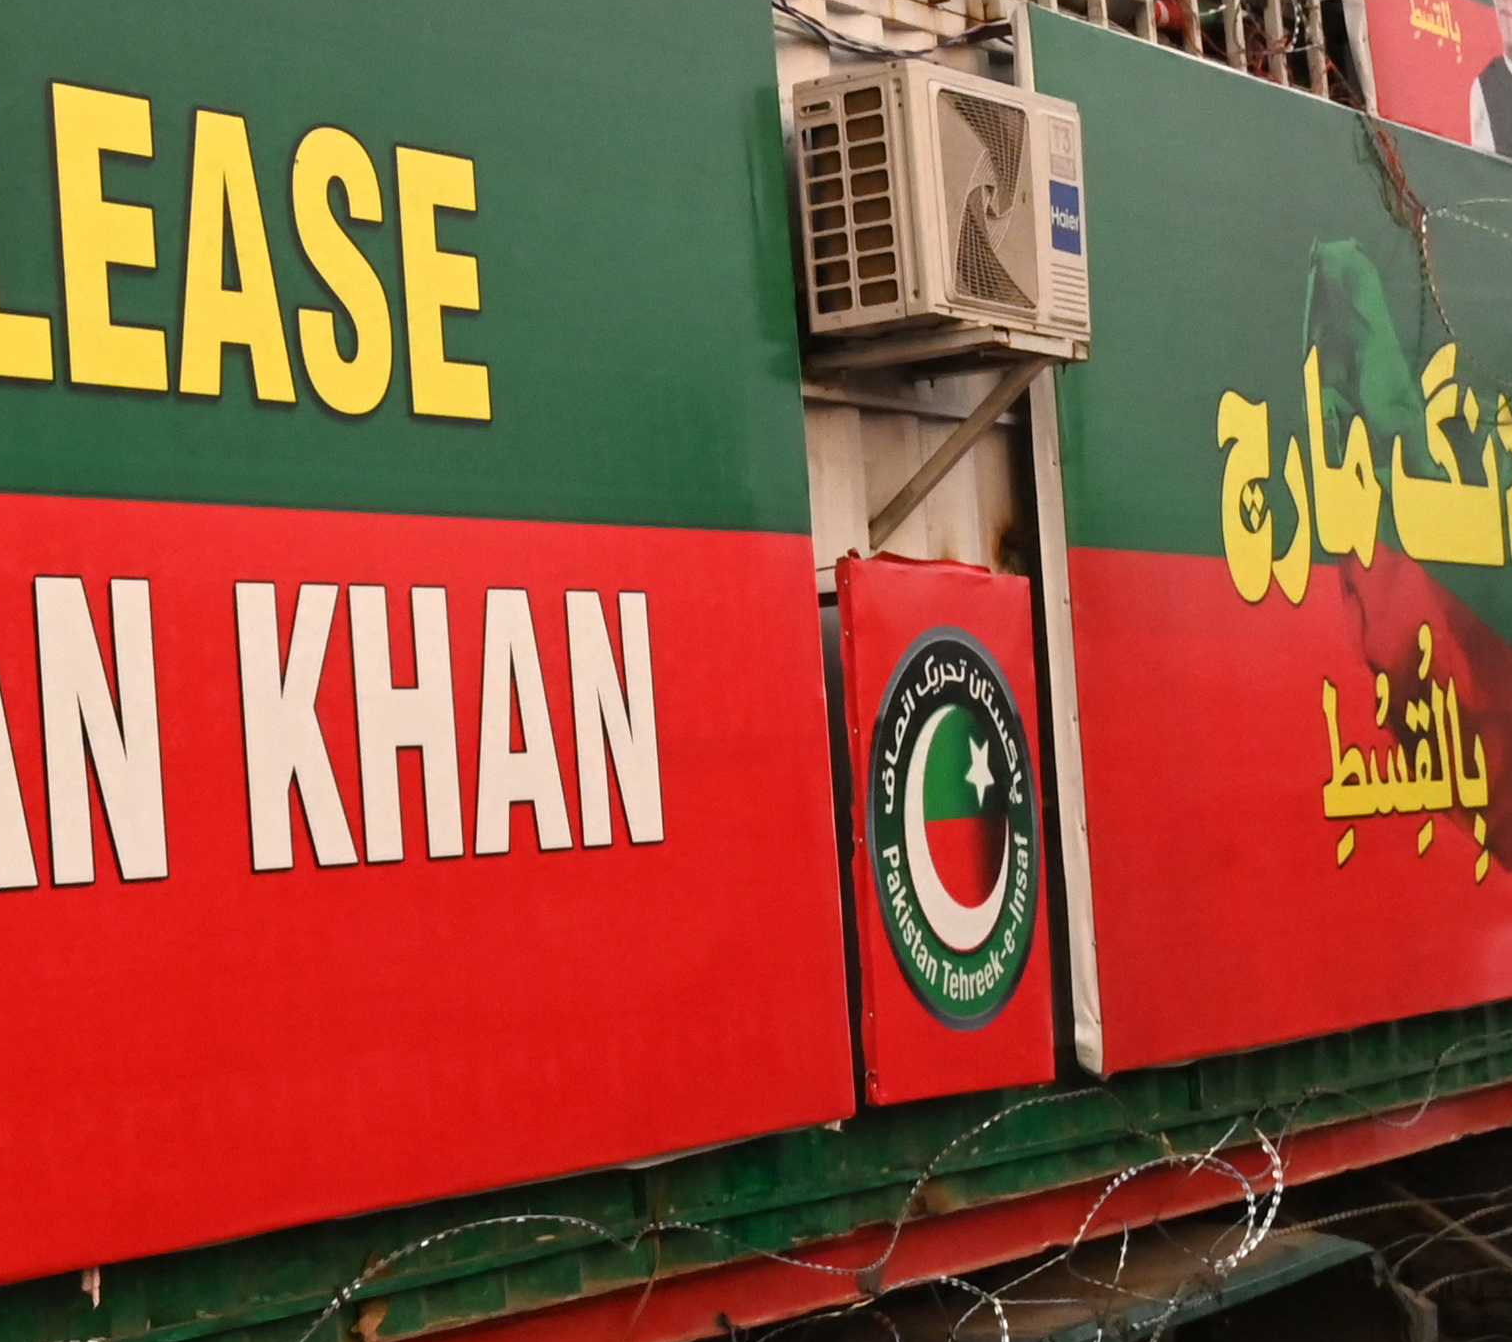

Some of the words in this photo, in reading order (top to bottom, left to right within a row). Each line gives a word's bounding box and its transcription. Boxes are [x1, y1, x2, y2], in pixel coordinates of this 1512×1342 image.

[1051, 205, 1080, 232] Haier
[1217, 344, 1382, 606] مارچ
[234, 579, 666, 874] KHAN
[916, 655, 966, 697] تحریک
[969, 668, 1023, 806] پاکستان
[884, 689, 915, 815] انصاف
[883, 848, 937, 987] Pakistan
[941, 832, 1029, 1002] Tehreek-e-Insaf
